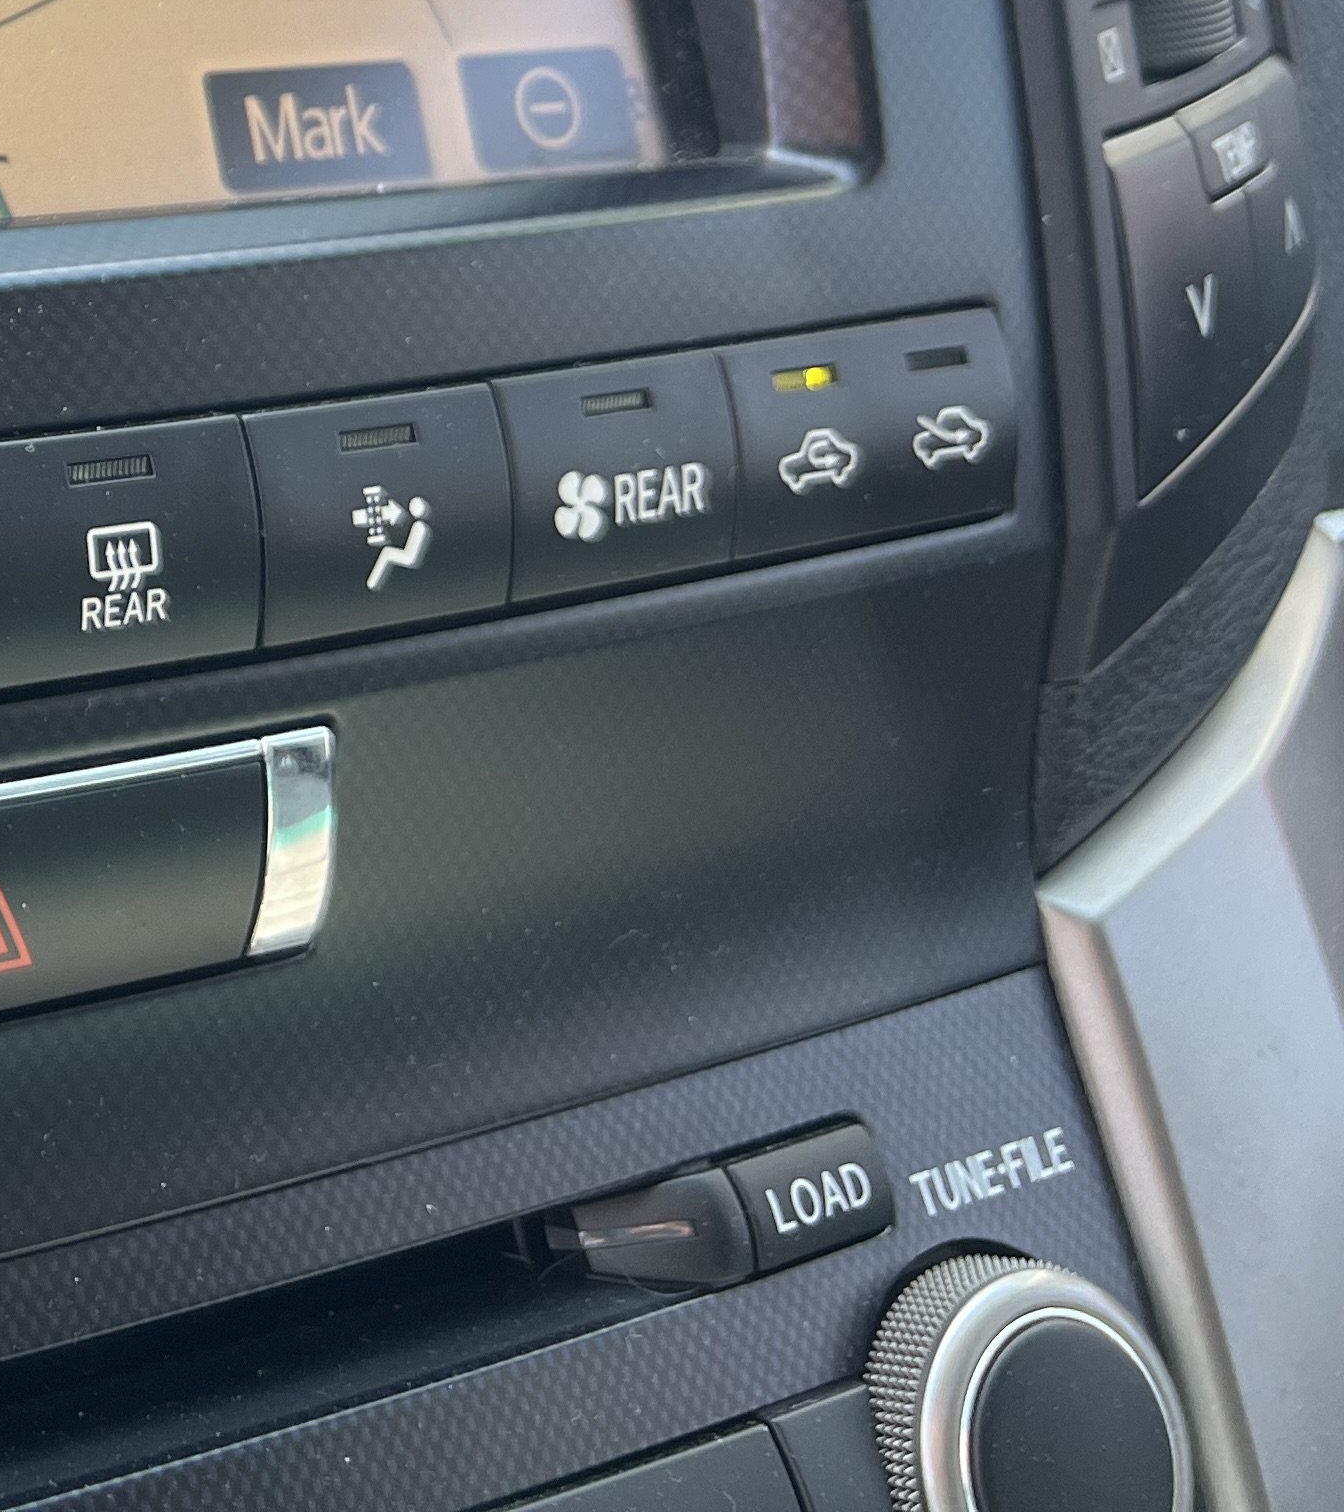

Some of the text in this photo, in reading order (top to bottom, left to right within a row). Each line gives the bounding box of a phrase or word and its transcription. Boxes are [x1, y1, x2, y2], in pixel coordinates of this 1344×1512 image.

[244, 82, 391, 165] Mark
[613, 461, 713, 528] REAR
[81, 588, 171, 632] REAR
[763, 1160, 873, 1235] LOAD
